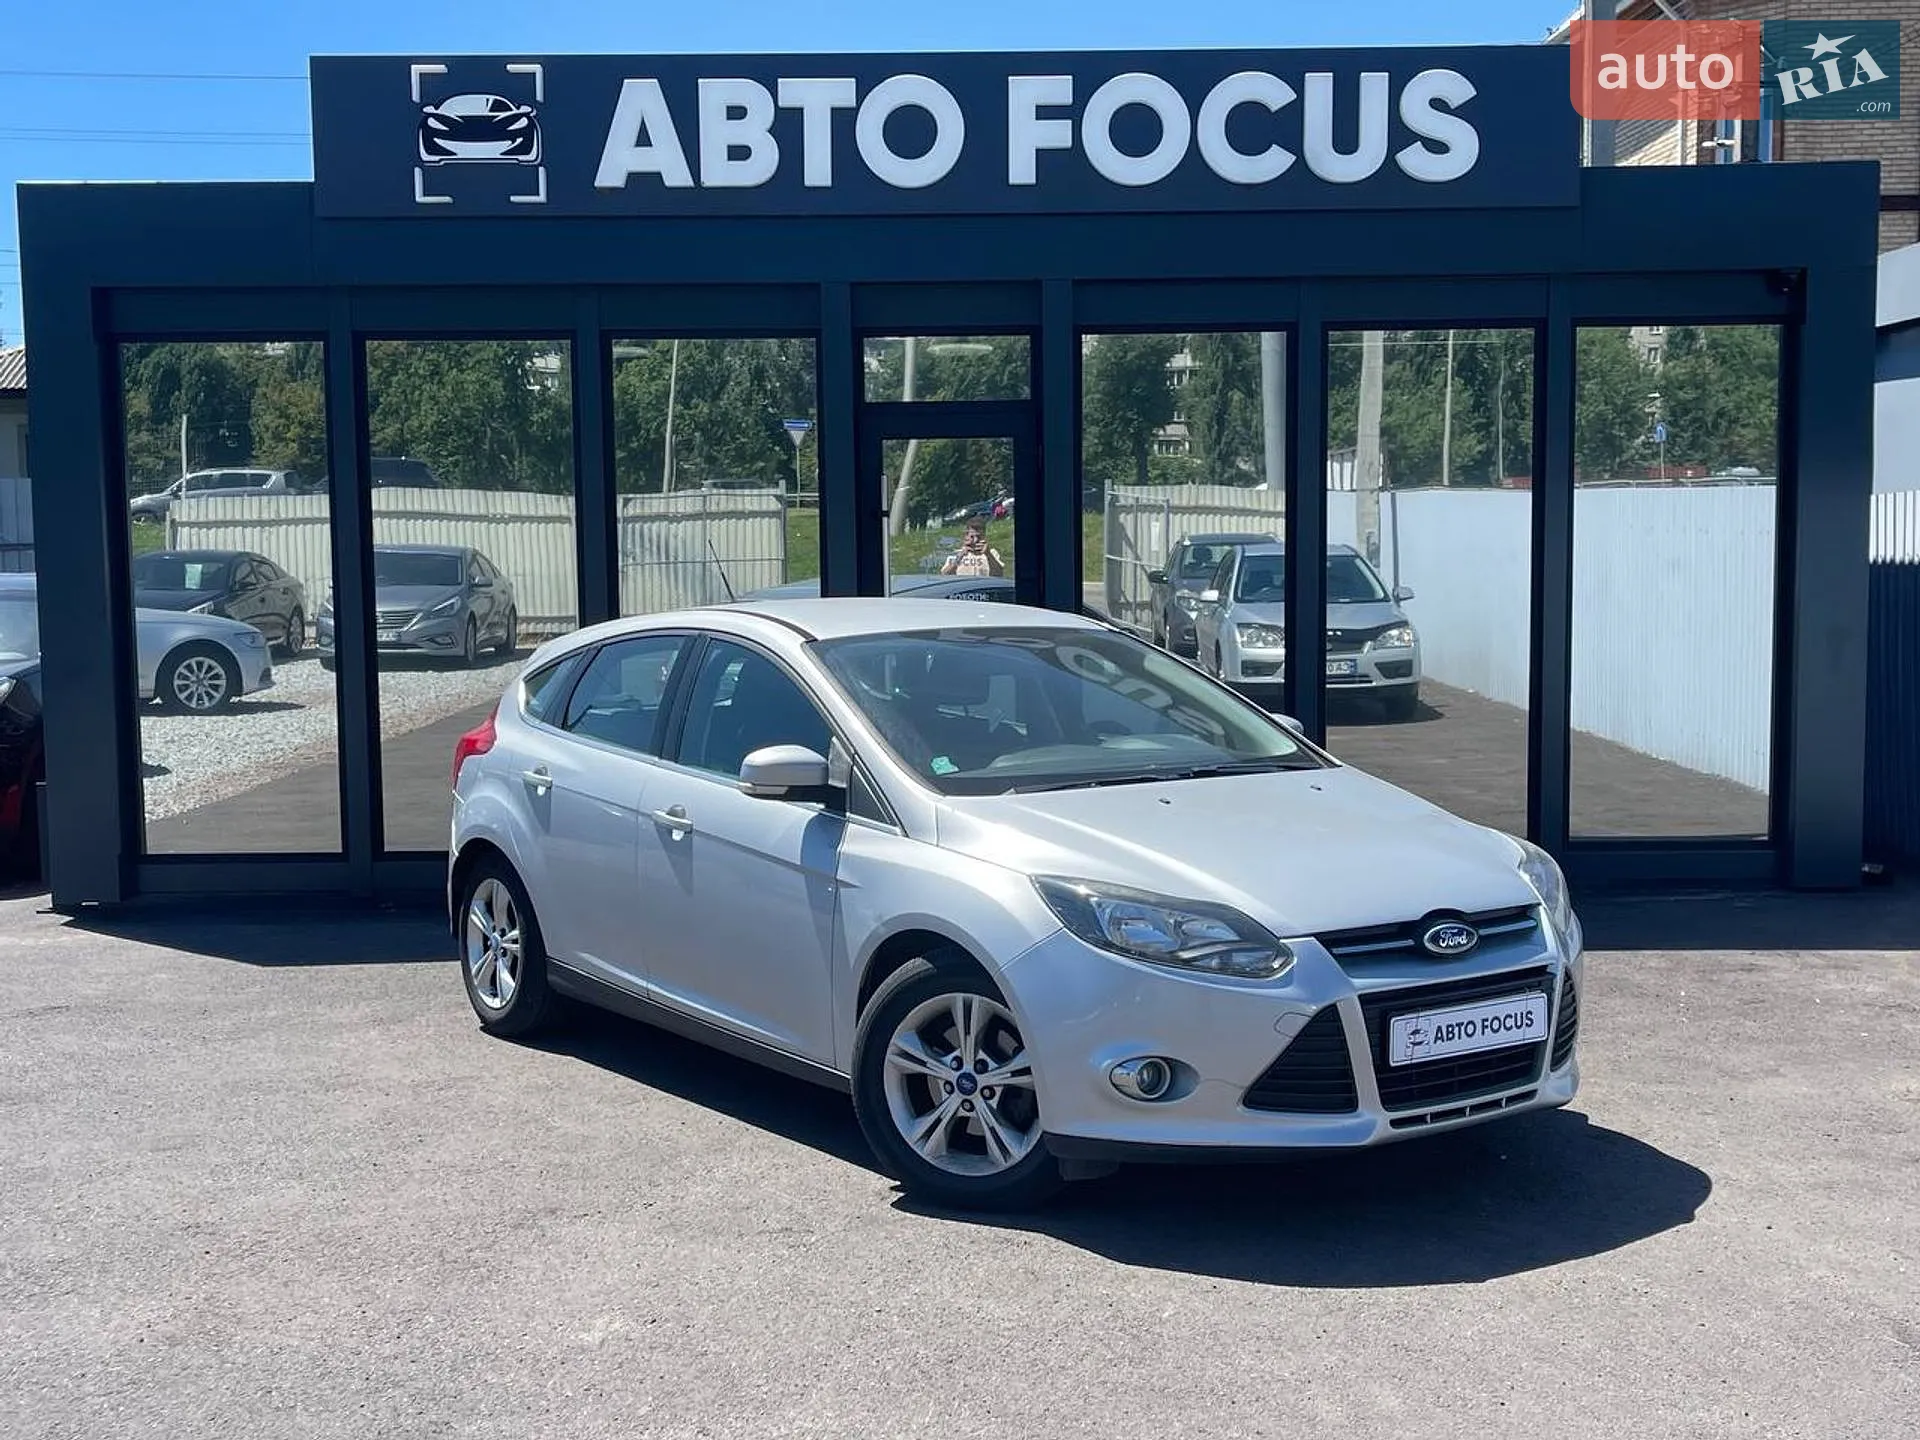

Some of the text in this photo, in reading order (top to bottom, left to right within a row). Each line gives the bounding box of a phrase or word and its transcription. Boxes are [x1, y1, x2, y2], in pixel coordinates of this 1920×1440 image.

[594, 69, 1480, 189] АВТО FOCUS
[1439, 929, 1467, 947] Ford
[1433, 1009, 1534, 1044] АВТО FOCUS
